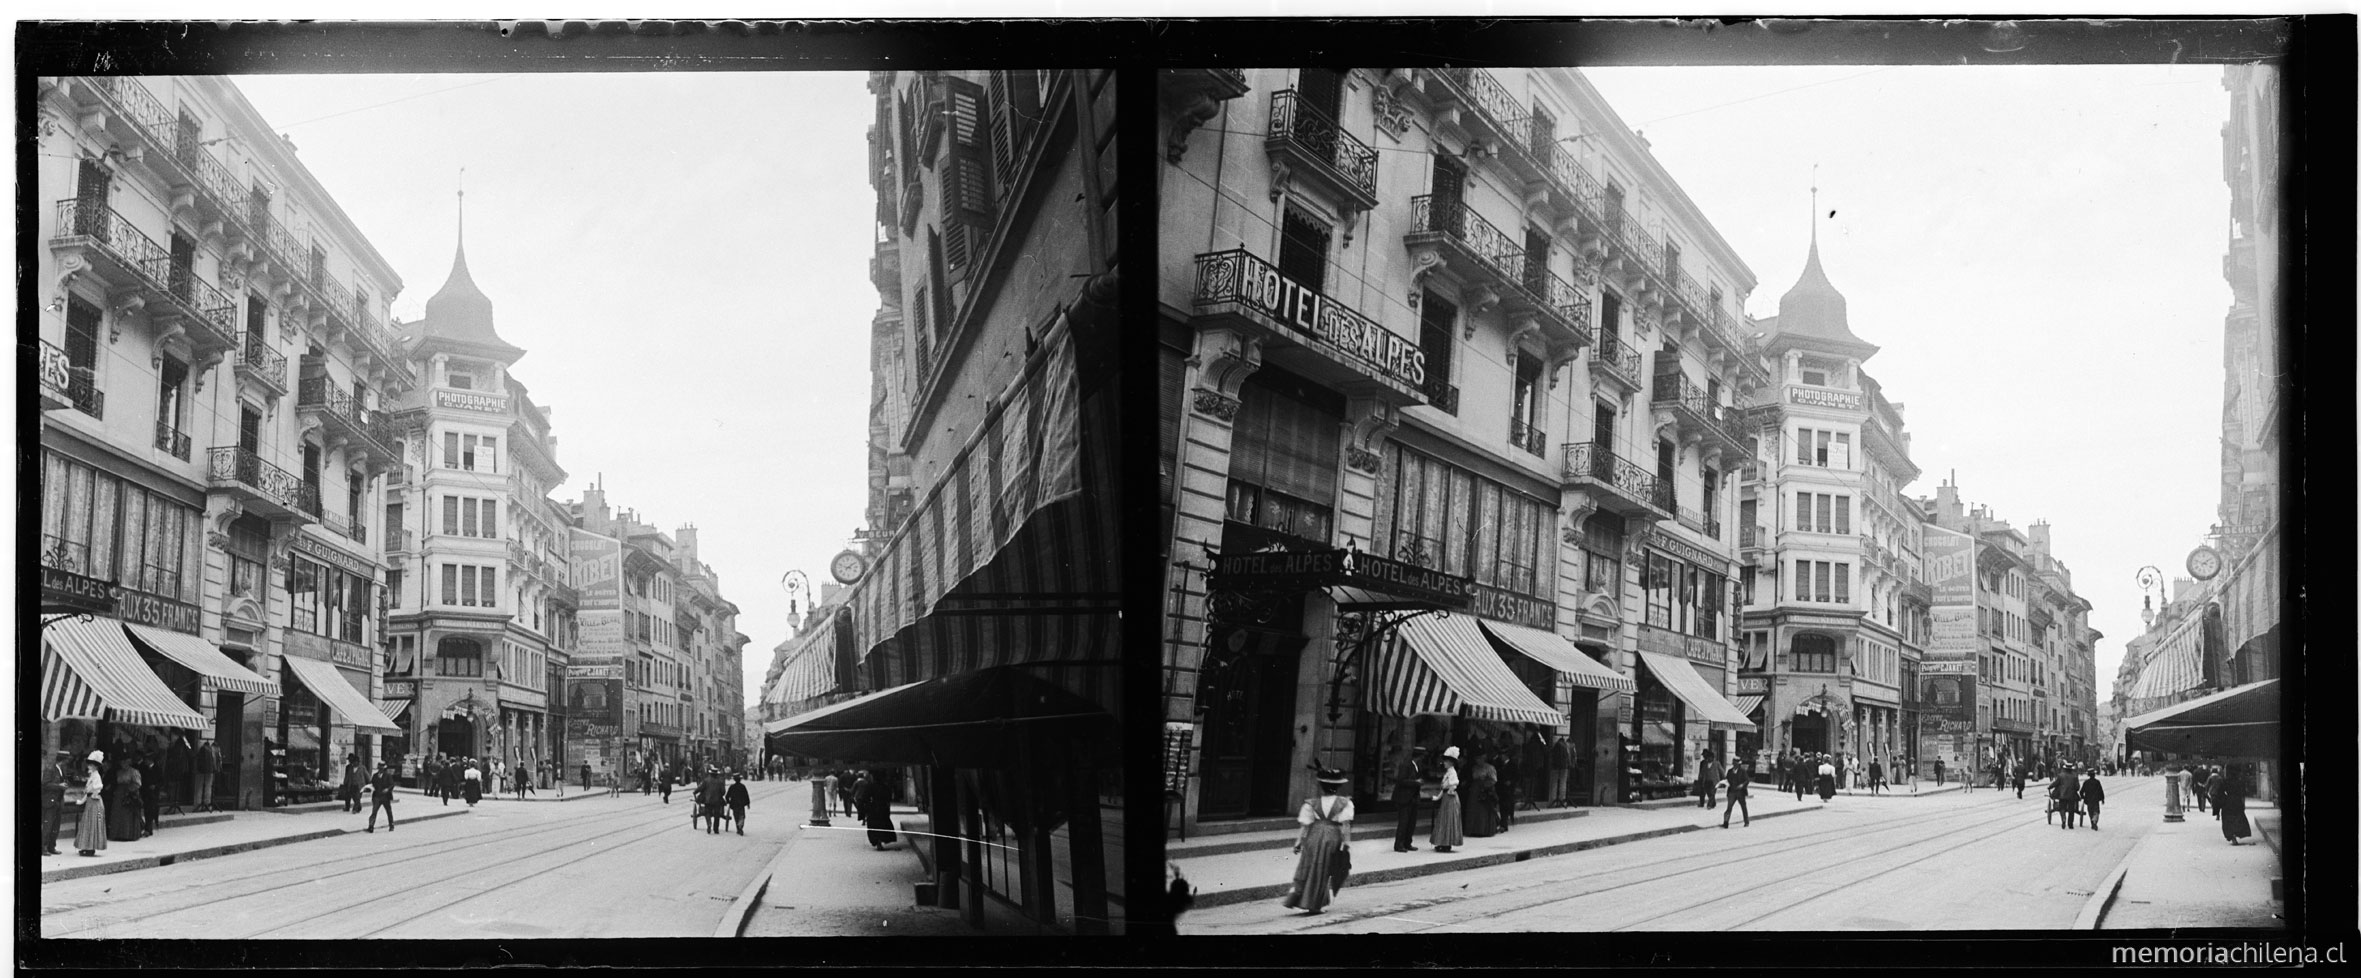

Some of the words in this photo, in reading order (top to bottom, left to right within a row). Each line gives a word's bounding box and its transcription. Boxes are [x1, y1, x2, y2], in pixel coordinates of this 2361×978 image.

[1242, 256, 1328, 336] HOTEL
[1329, 314, 1360, 351] DES
[1360, 322, 1425, 385] ALPES
[439, 391, 507, 409] PHOTOGRAPHIE
[1792, 388, 1861, 406] PHOTOGRAPHIE
[314, 543, 359, 572] GUIGNARD
[1223, 556, 1267, 576] HOTEL
[1284, 554, 1333, 574] ALPES
[1669, 540, 1714, 567] GUIGNARD
[570, 552, 618, 592] RIBET
[1361, 556, 1407, 585] HOTEL
[1408, 571, 1420, 587] des
[1420, 572, 1461, 596] ALPES
[1923, 548, 1971, 588] RIBET
[52, 577, 64, 591] des
[64, 575, 105, 599] ALPES
[118, 591, 141, 621] AUX
[142, 598, 160, 625] 35
[162, 602, 198, 632] FRANCS
[1473, 588, 1497, 617] AUX
[1497, 593, 1516, 621] 35
[1517, 599, 1553, 628] FRANCS
[584, 723, 619, 737] RICHARD
[1937, 719, 1972, 733] RICHARD
